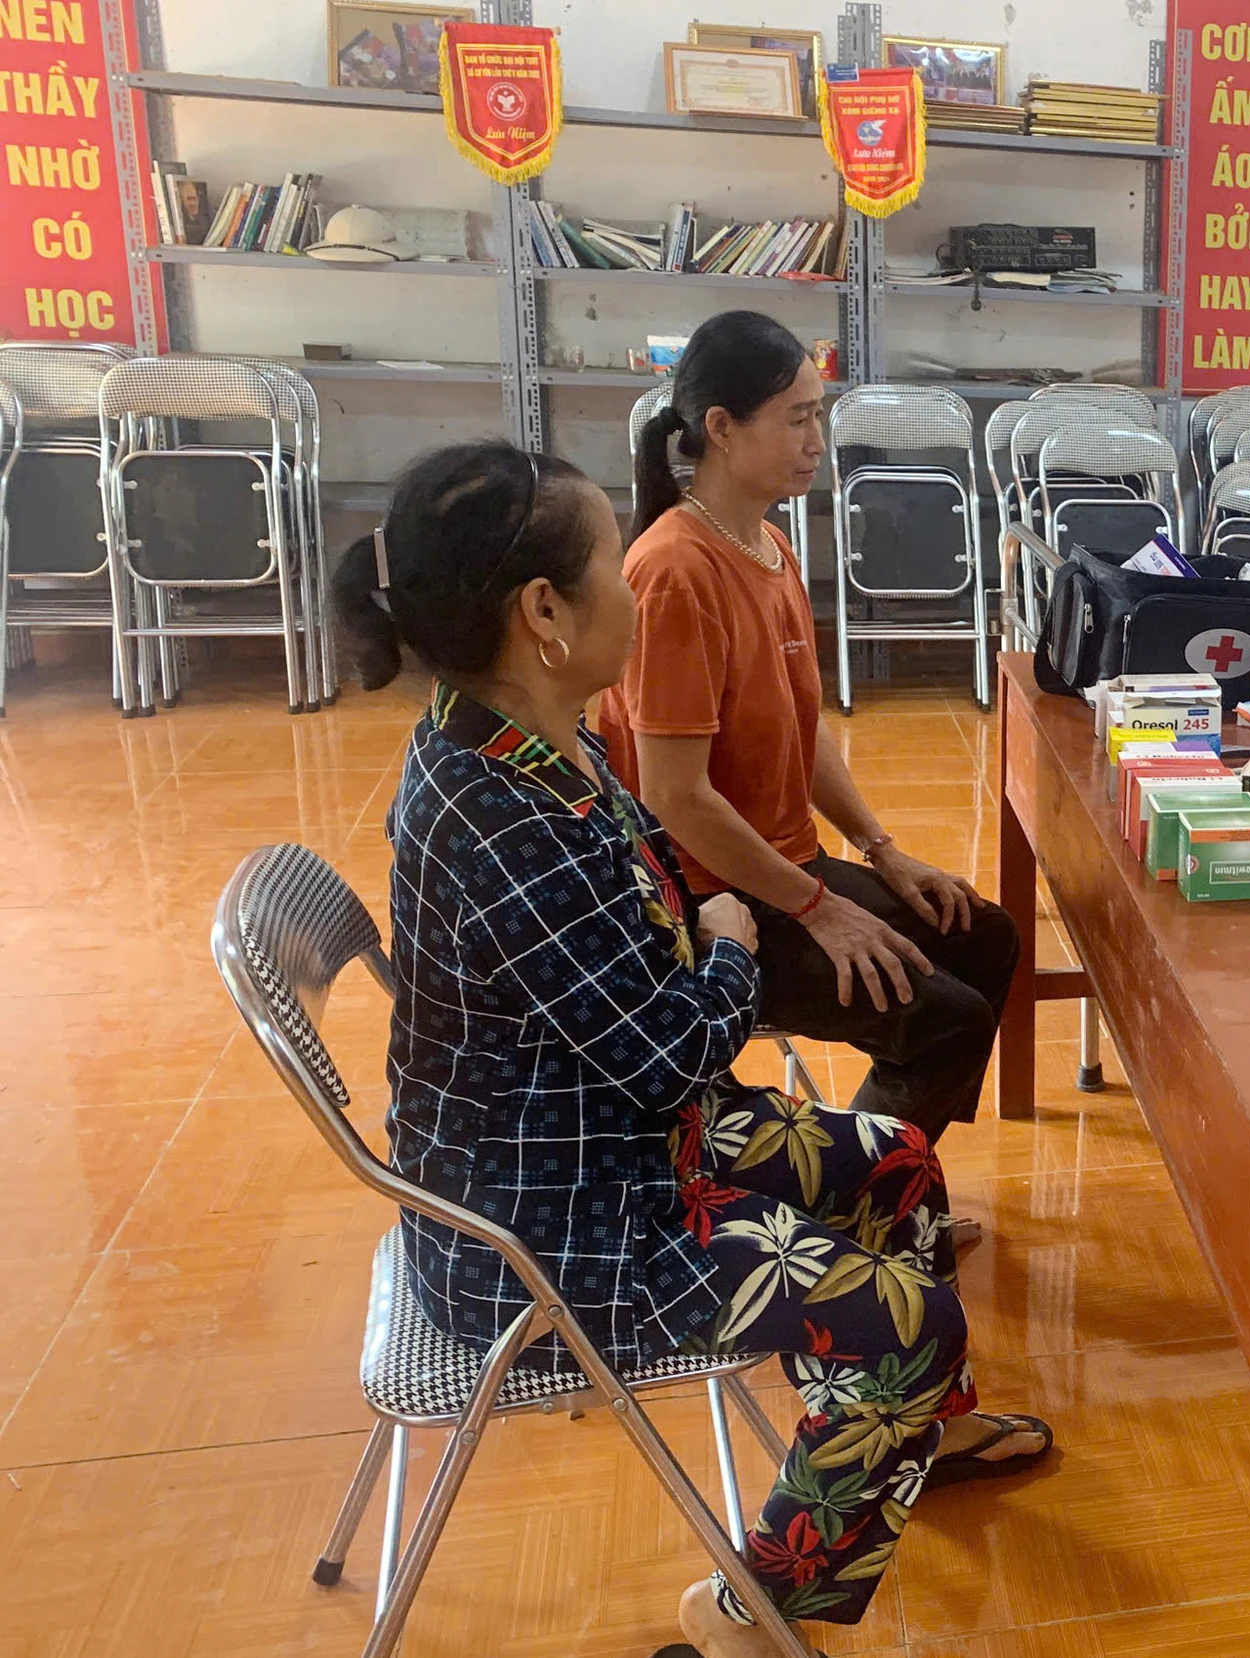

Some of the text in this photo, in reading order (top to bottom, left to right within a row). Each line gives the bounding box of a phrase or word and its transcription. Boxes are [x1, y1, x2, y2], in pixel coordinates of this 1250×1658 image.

[0, 60, 99, 118] THẦY
[5, 139, 100, 190] NHỜ
[32, 211, 93, 260] CÓ
[25, 288, 115, 337] HỌC
[1132, 718, 1210, 730] Oresol 245
